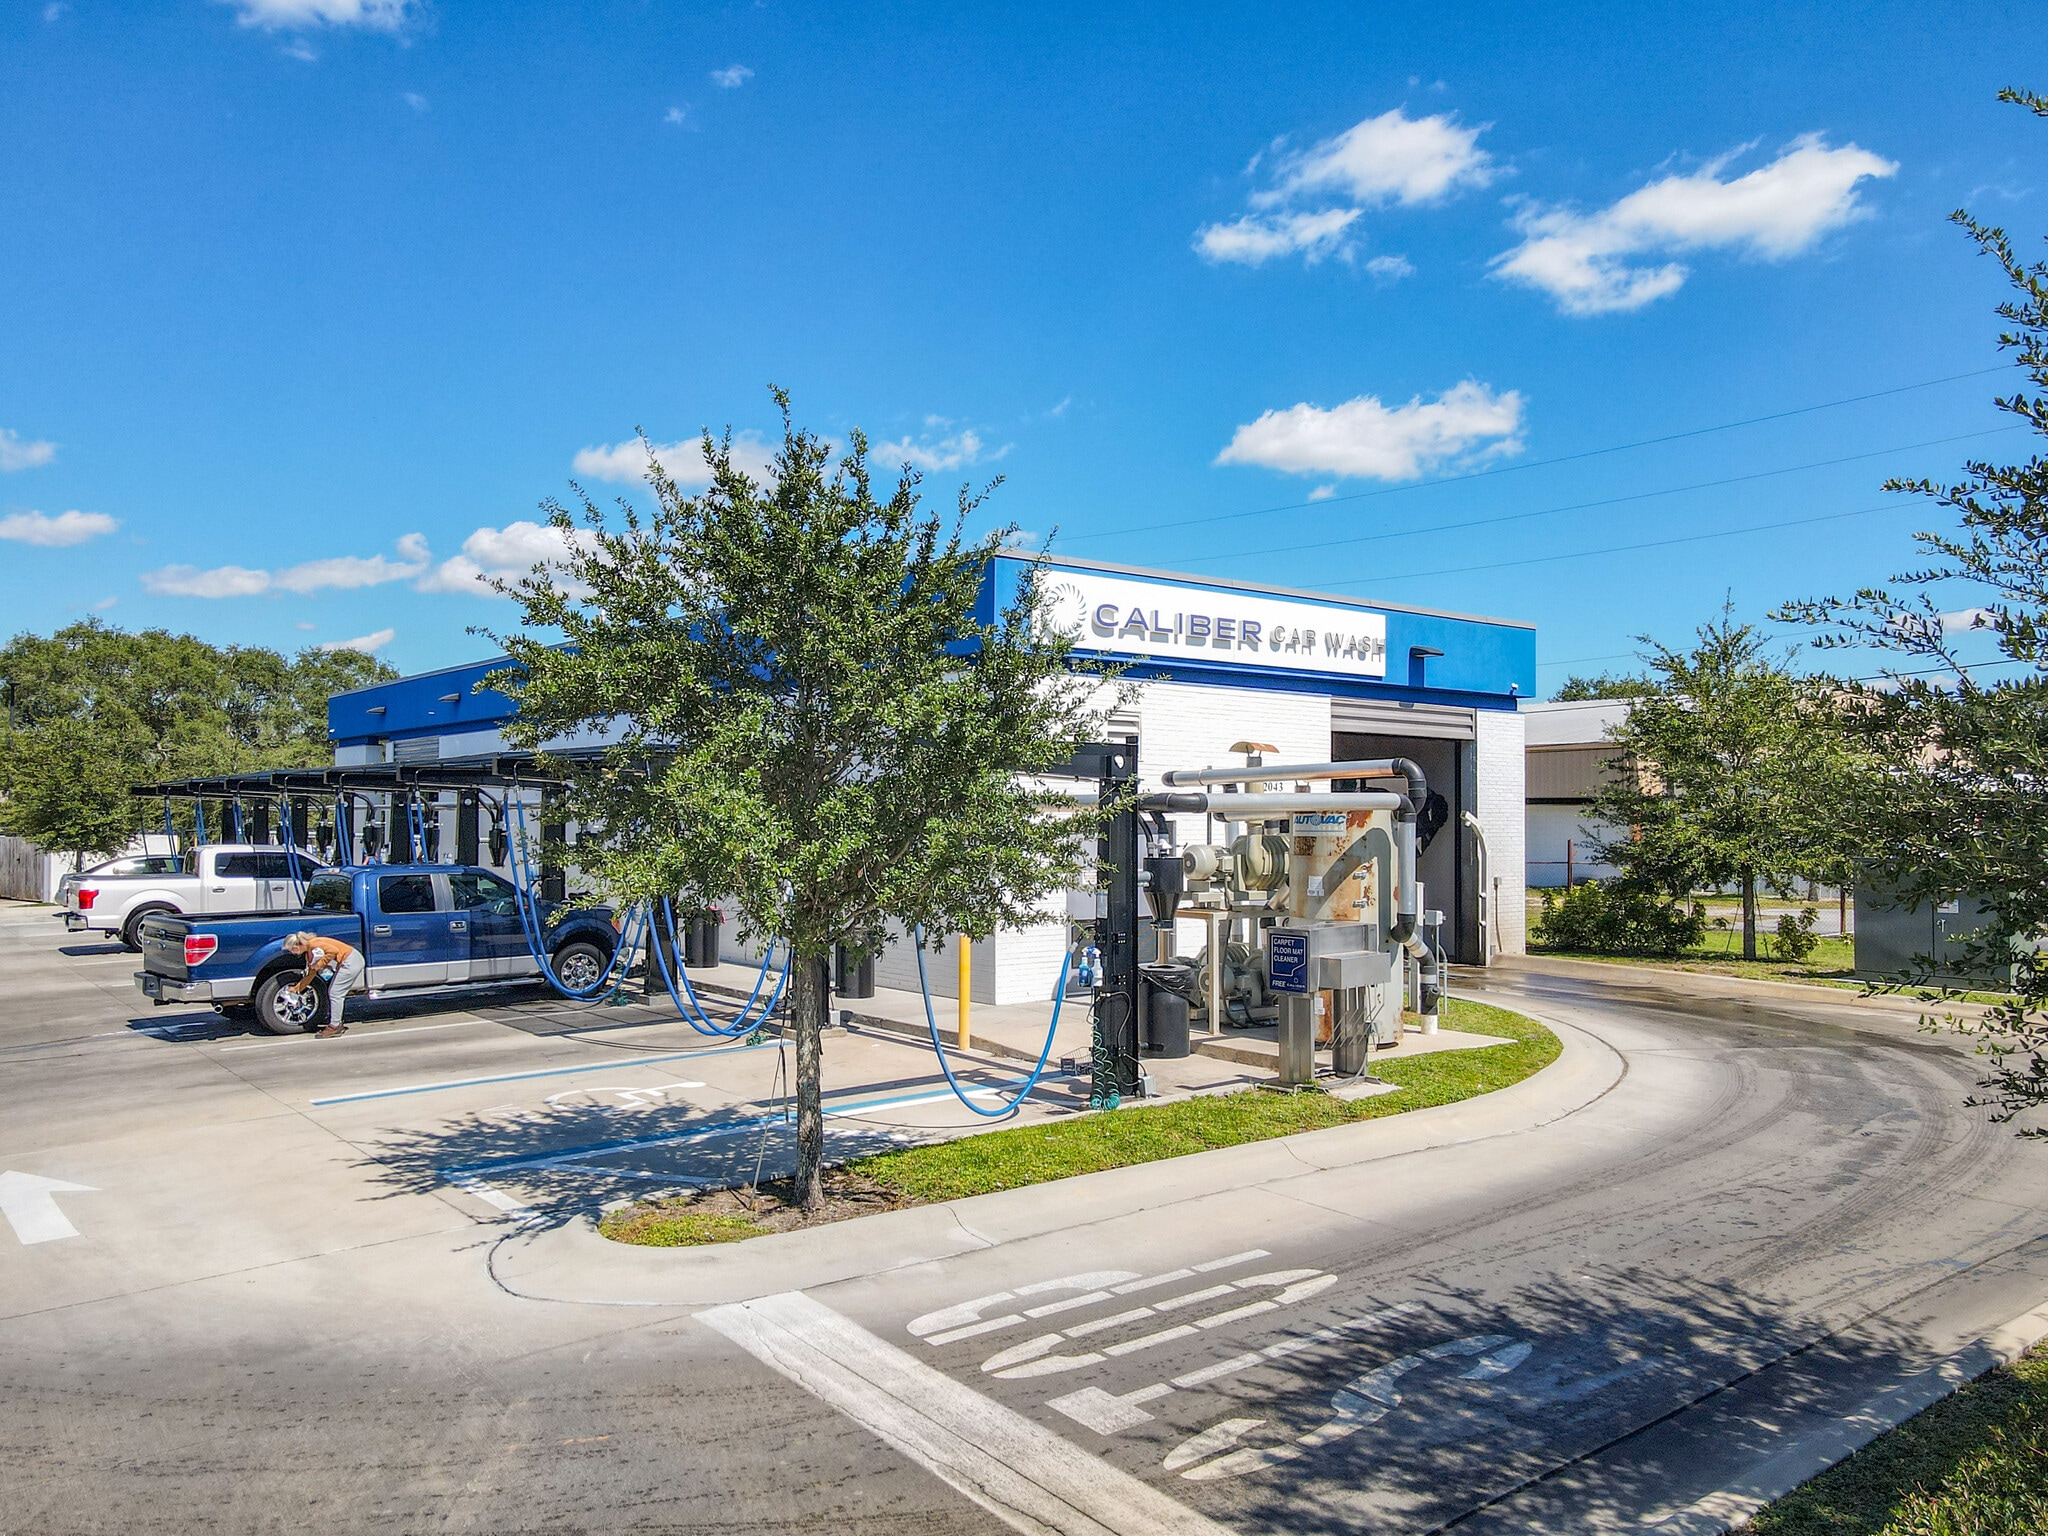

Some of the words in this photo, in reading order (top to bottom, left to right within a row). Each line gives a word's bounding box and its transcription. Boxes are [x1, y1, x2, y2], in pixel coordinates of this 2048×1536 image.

[1095, 603, 1262, 643] CALIBER
[1273, 625, 1316, 645] CAR
[1327, 632, 1385, 654] WASH
[1263, 782, 1283, 792] 2043
[1273, 938, 1295, 946] CARPET
[1273, 946, 1291, 954] FLOOR
[1273, 955, 1298, 963] CLEANER
[906, 1249, 1533, 1480] STOP
